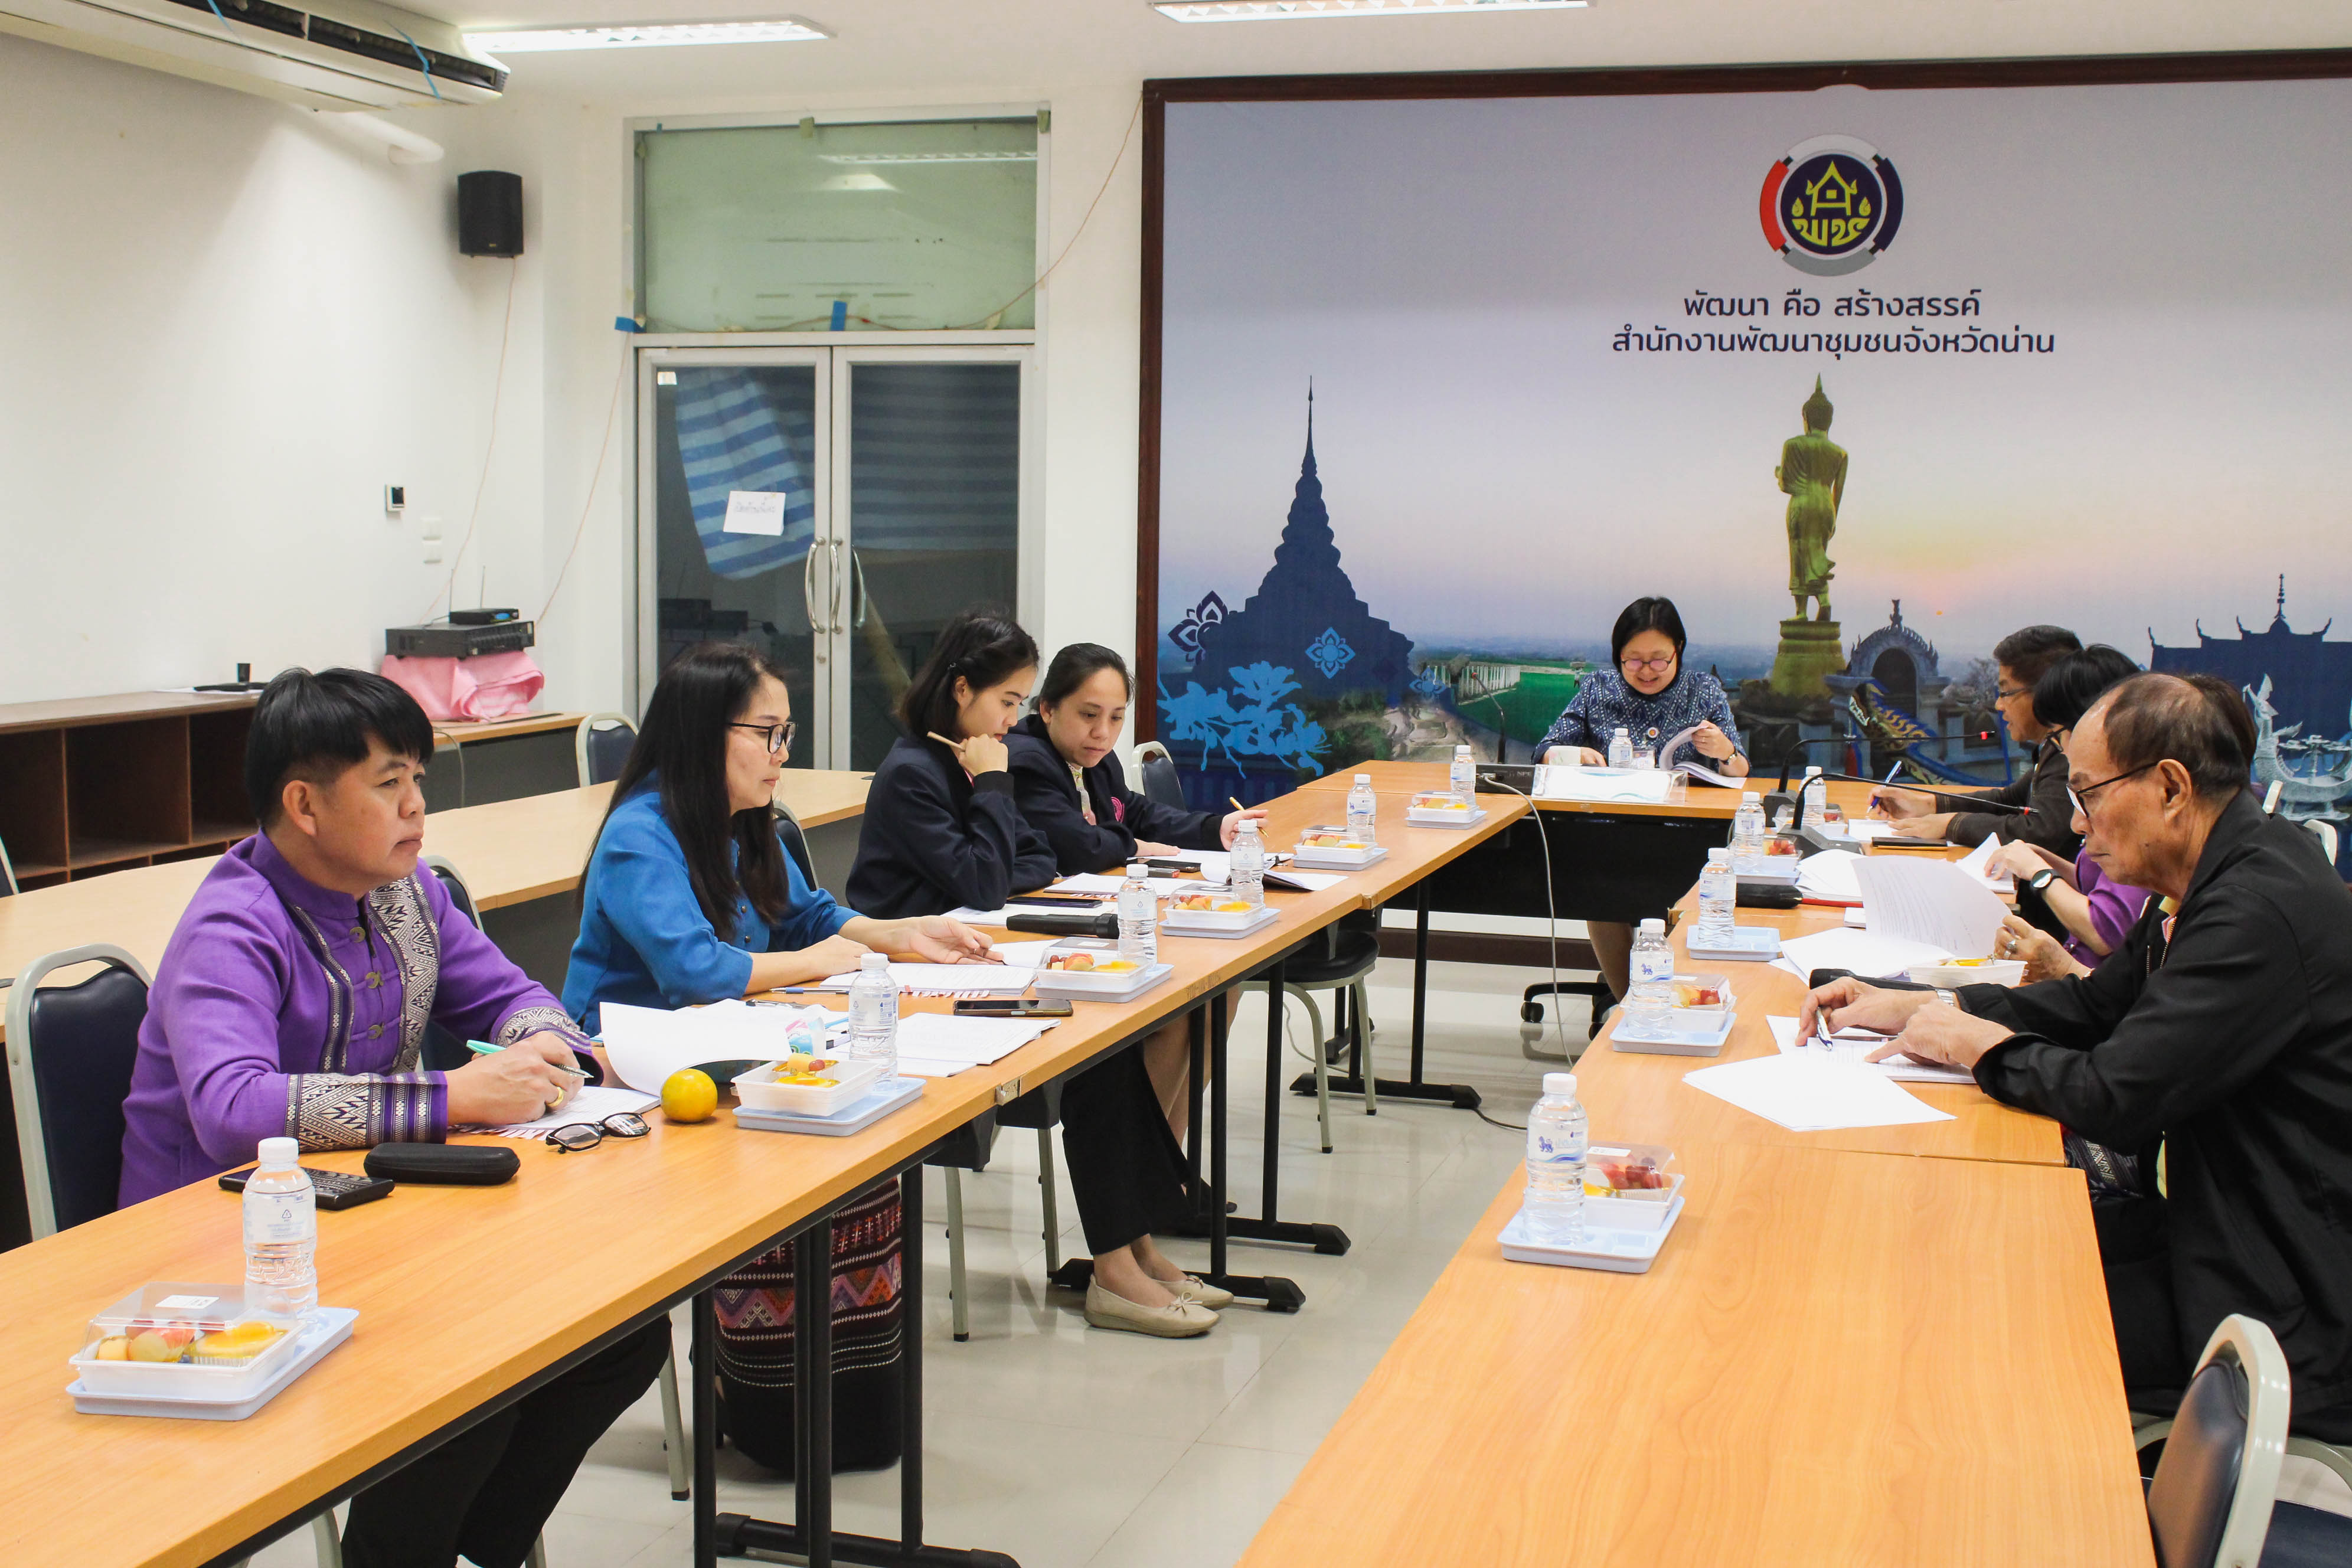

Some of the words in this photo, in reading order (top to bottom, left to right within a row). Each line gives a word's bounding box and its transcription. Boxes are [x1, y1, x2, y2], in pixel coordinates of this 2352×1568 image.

[1684, 289, 1769, 316] พัฒนา
[1784, 288, 1821, 316] คือ
[1834, 288, 1982, 316] สร้างสรรค์
[1612, 323, 2055, 360] สำนักงานพัฒนาชุมชนจังหวัดน่าน
